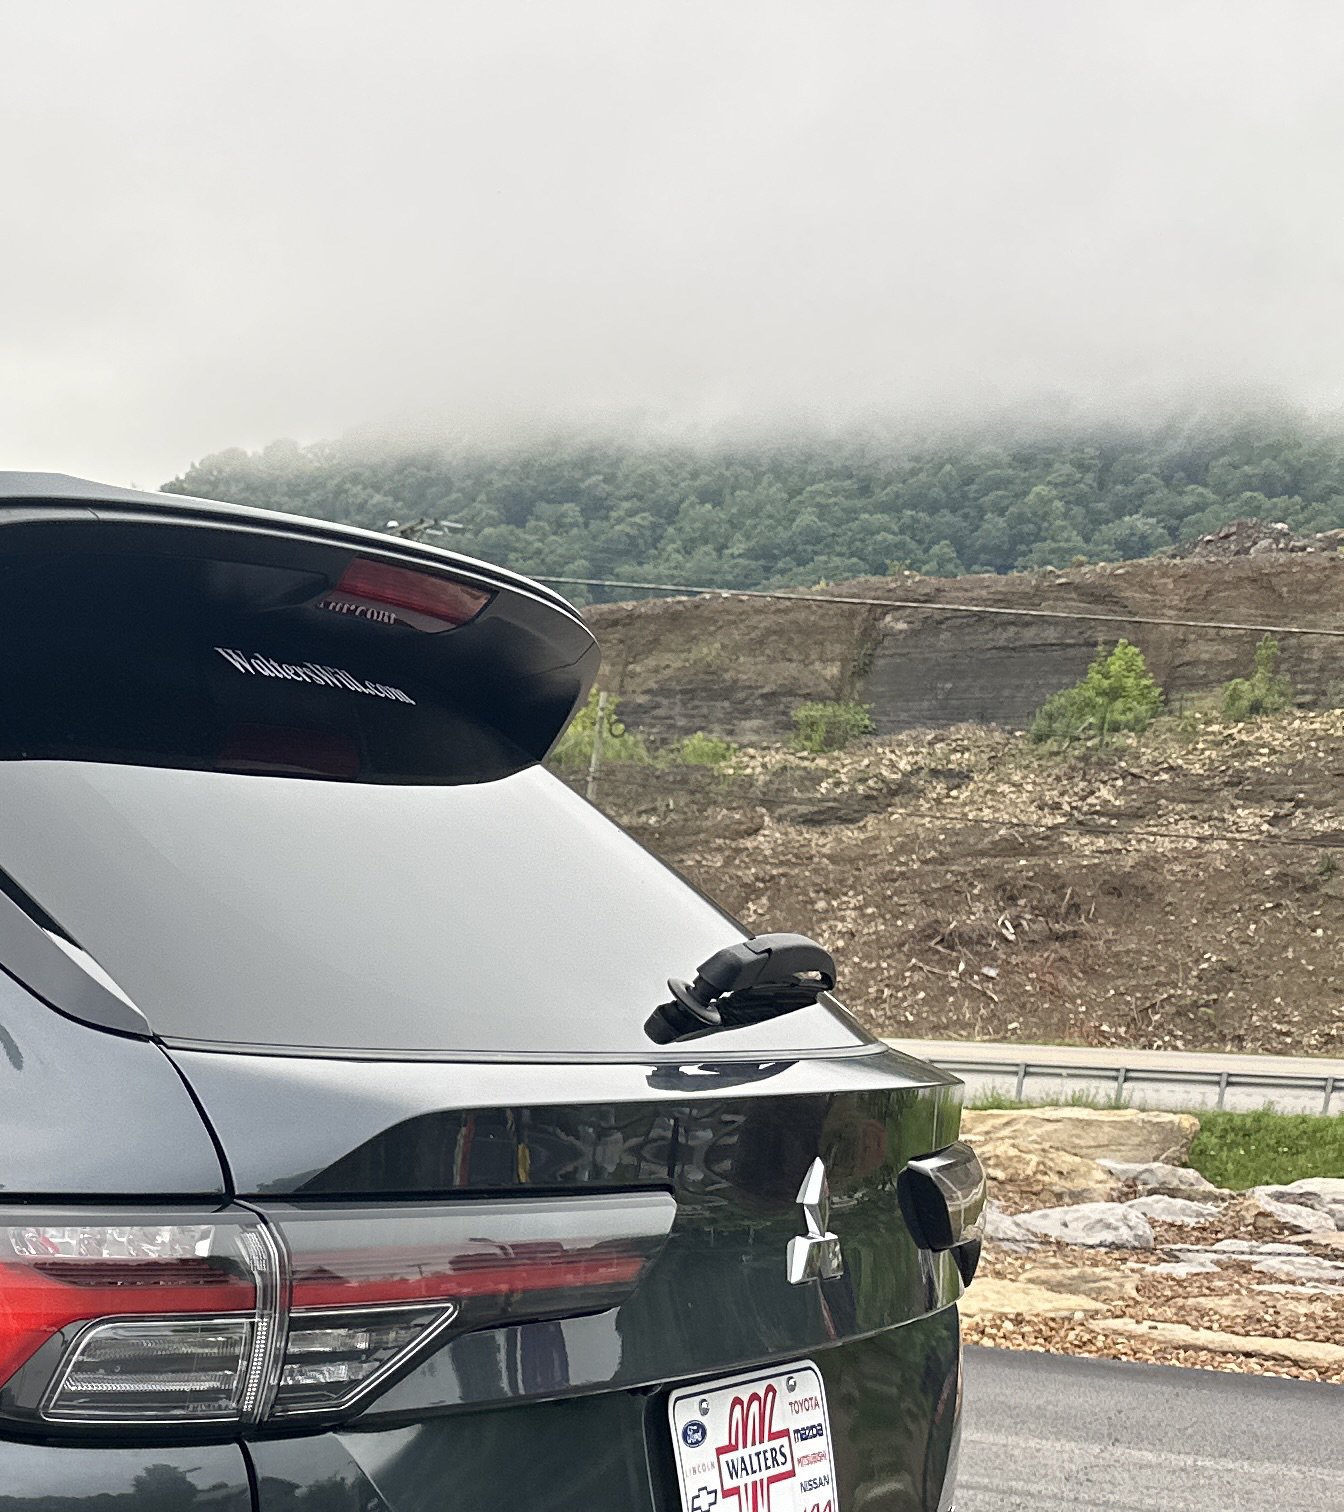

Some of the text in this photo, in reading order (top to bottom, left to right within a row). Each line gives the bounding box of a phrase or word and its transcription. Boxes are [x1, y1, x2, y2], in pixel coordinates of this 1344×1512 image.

[214, 647, 416, 705] WaltersWill.com
[788, 1396, 820, 1415] TOYOTA
[725, 1444, 788, 1480] WALTERS
[800, 1473, 829, 1493] NISSAN
